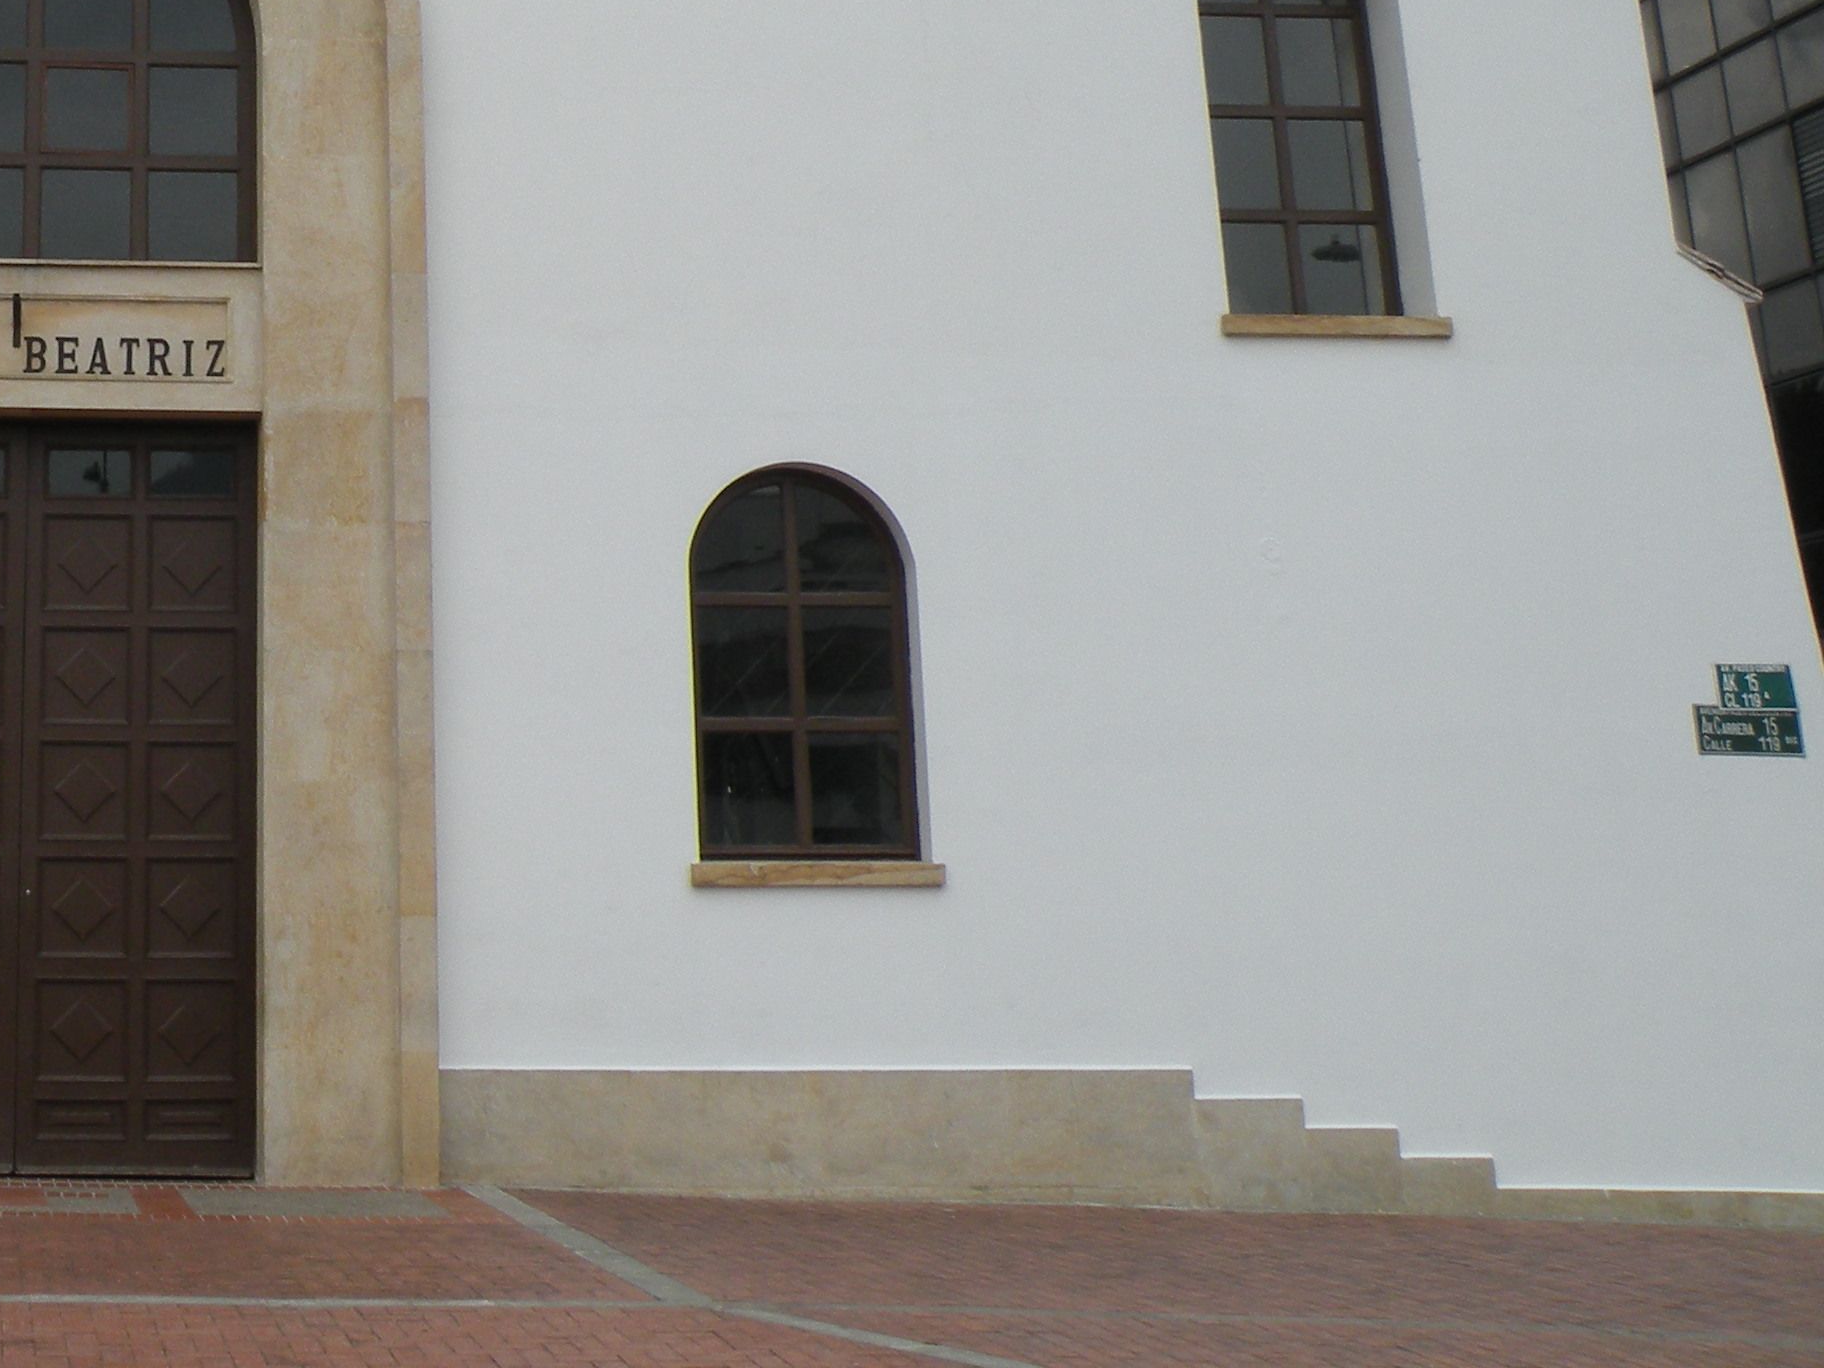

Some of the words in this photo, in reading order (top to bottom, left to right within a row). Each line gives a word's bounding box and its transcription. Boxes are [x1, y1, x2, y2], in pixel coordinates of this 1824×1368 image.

[23, 336, 226, 378] BEATRIZ
[1762, 716, 1779, 736] 15
[1758, 735, 1782, 752] 119
